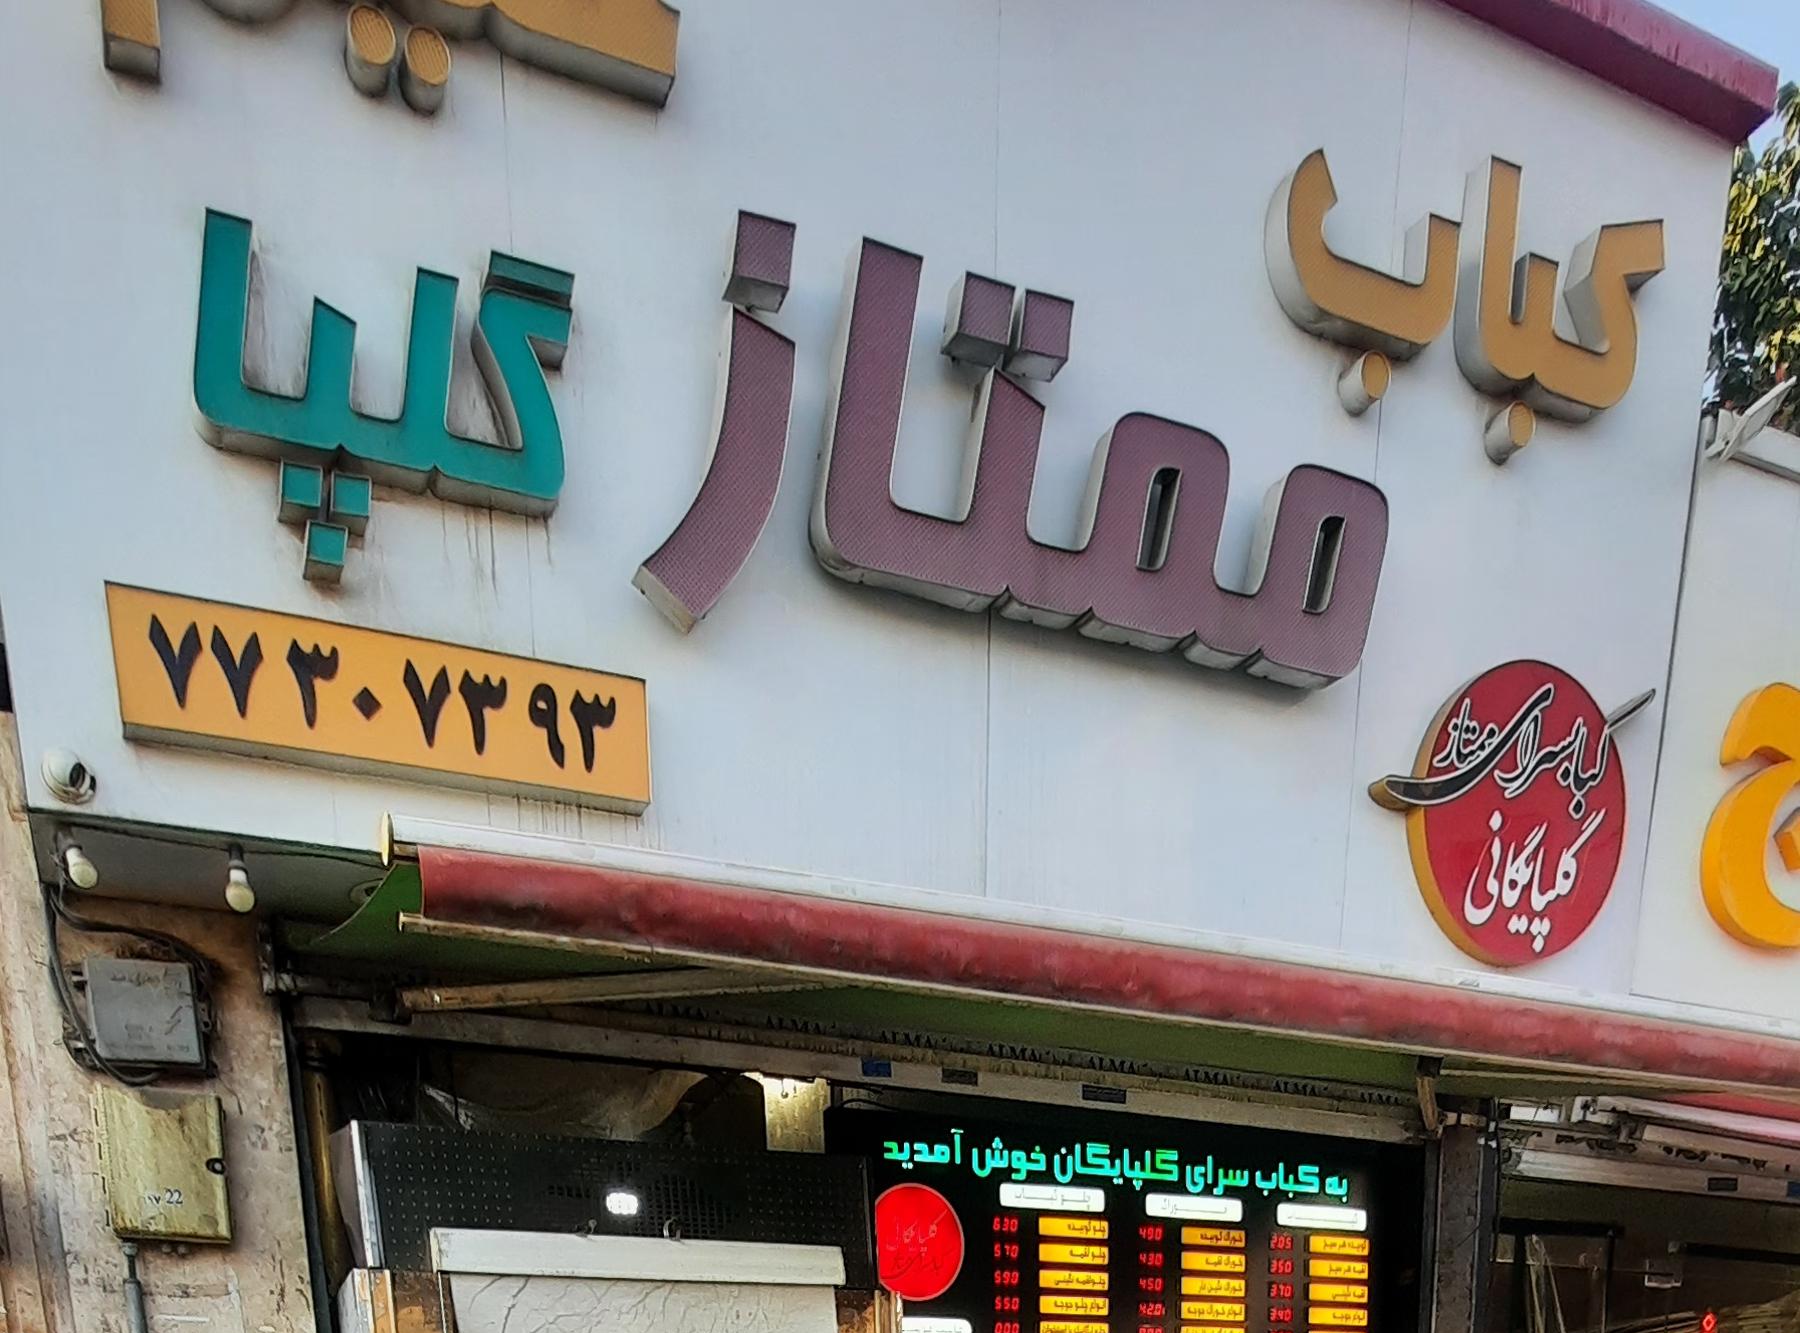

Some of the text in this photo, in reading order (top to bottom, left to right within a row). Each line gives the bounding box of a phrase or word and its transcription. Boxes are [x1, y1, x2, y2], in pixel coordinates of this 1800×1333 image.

[1266, 148, 1664, 464] کباب
[193, 207, 575, 582] گلپا
[632, 208, 1390, 690] ممتاز
[148, 612, 617, 773] ۷۷۳۰۷۳۹۳
[1433, 698, 1499, 769] ممتاز
[1463, 808, 1606, 953] گلپایگانی
[883, 1128, 1348, 1203] به کباب سرای گلپایگان خوش آمدید
